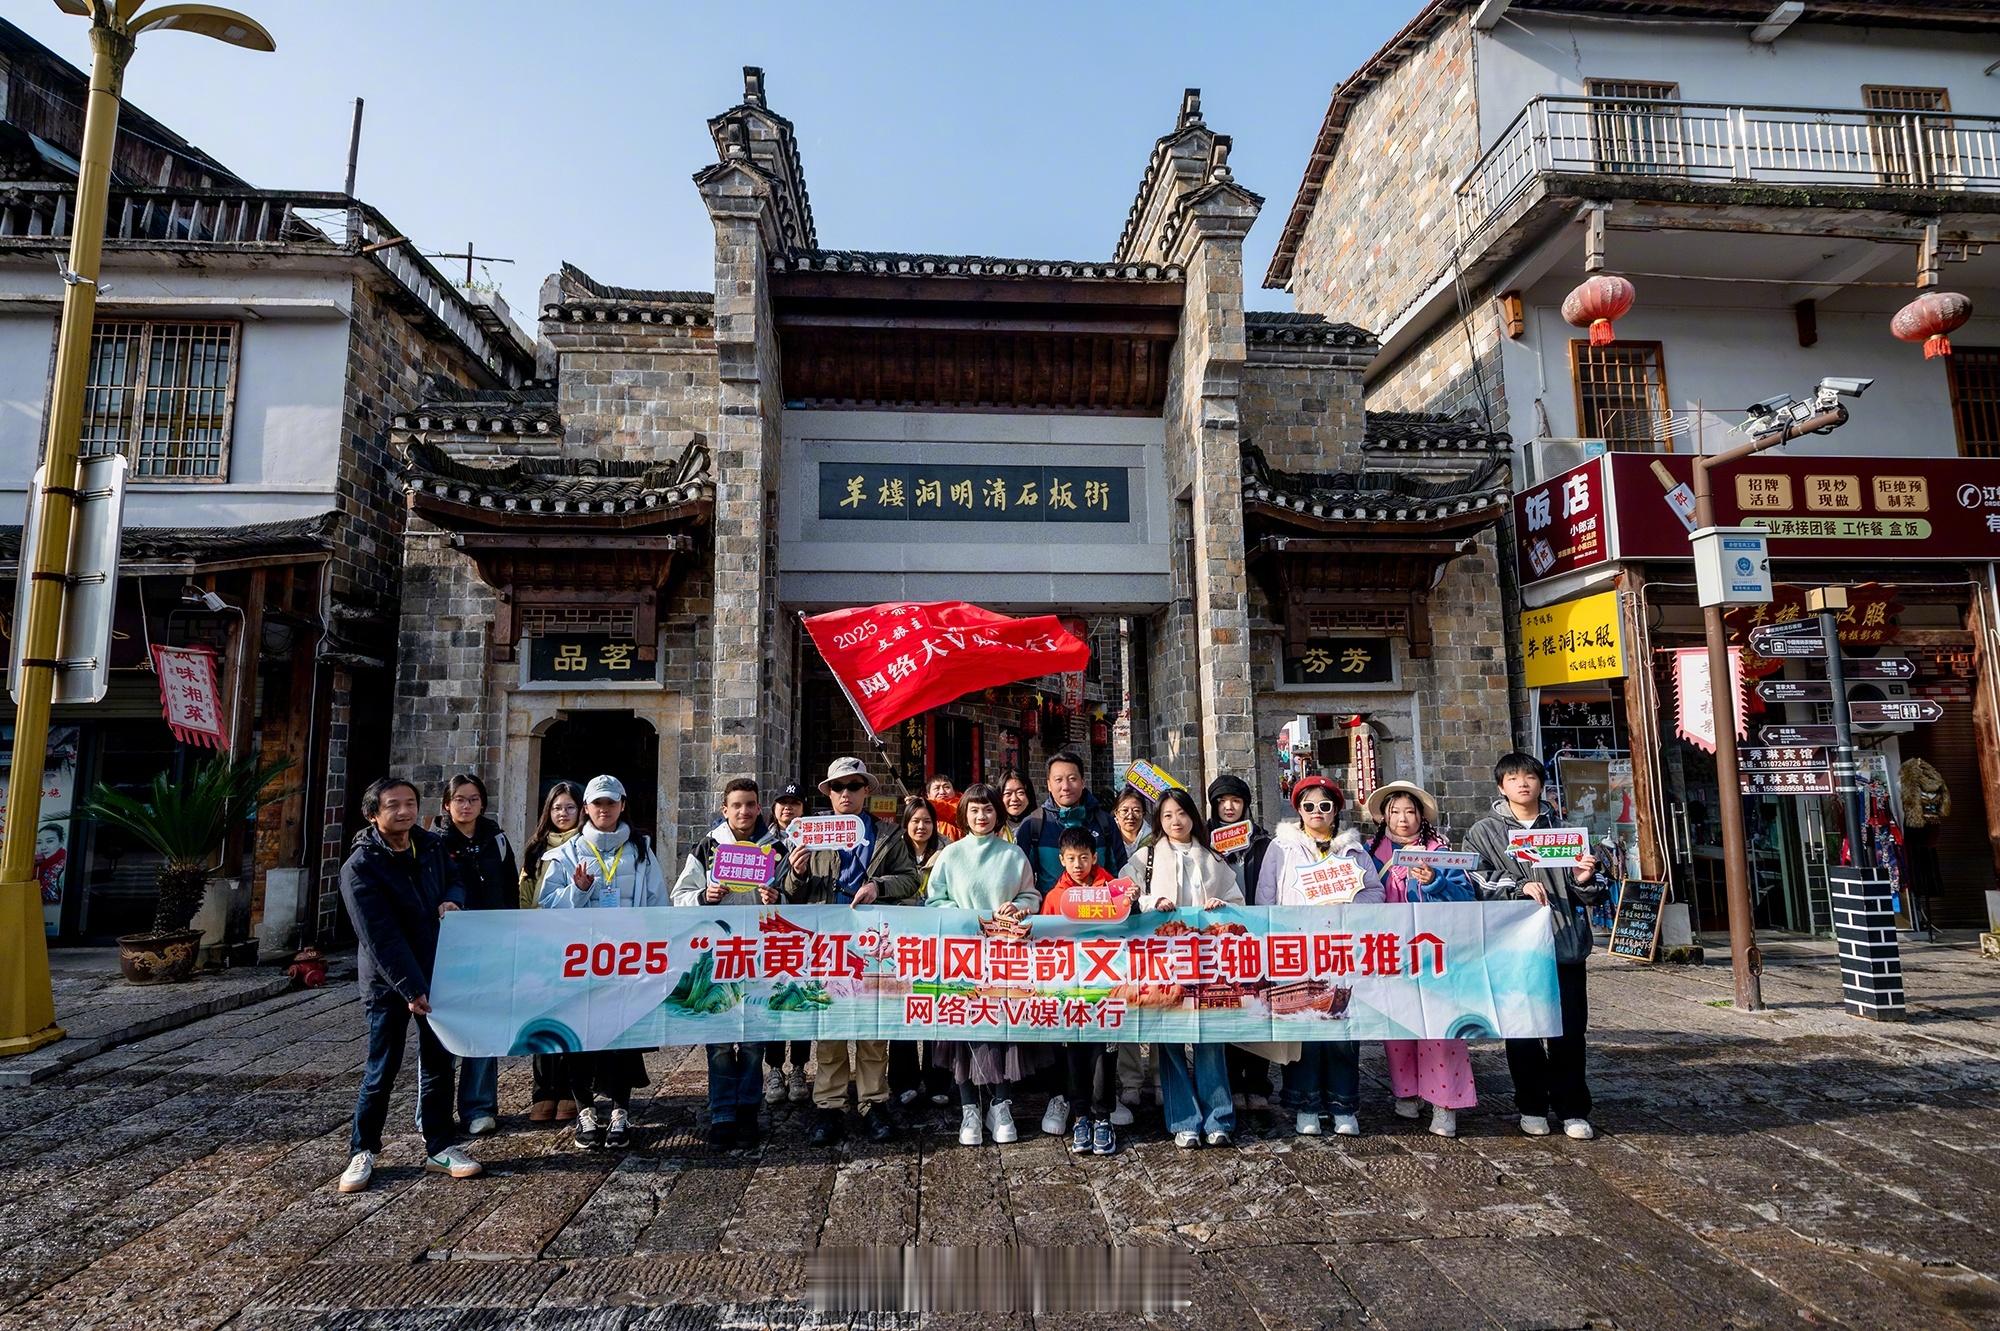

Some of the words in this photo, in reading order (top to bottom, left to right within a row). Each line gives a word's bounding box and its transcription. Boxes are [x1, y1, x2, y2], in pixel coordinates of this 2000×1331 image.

[1748, 478, 1780, 491] 招牌
[1817, 479, 1848, 491] 现炒
[1878, 479, 1922, 492] 拒绝预
[1749, 493, 1781, 506] 活鱼
[1818, 493, 1849, 507] 现做
[1887, 495, 1916, 507] 制菜
[1983, 486, 2000, 500] 订
[1525, 473, 1590, 532] 饭店
[1570, 515, 1598, 537] 小郎酒
[1842, 521, 1884, 536] 工作餐
[1889, 521, 1919, 537] 盒饭
[1748, 602, 1888, 627] 羊楼汉服
[833, 619, 878, 649] 2025
[1527, 623, 1615, 660] 羊楼洞汉服
[554, 644, 635, 671] 品茗
[1302, 648, 1372, 674] 芬芳
[1749, 748, 1813, 760] 秀琳宾馆
[1752, 773, 1816, 785] 有林宾馆
[802, 820, 857, 832] 漫游荆楚地
[720, 851, 768, 868] 知音湖北
[718, 865, 767, 881] 发现美好
[1300, 862, 1355, 886] 三国赤壁
[1068, 888, 1110, 904] 赤黄红
[1305, 876, 1360, 901] 英雄咸宁
[1077, 903, 1118, 919] 潮天下
[905, 994, 1128, 1027] 网络大V媒体行
